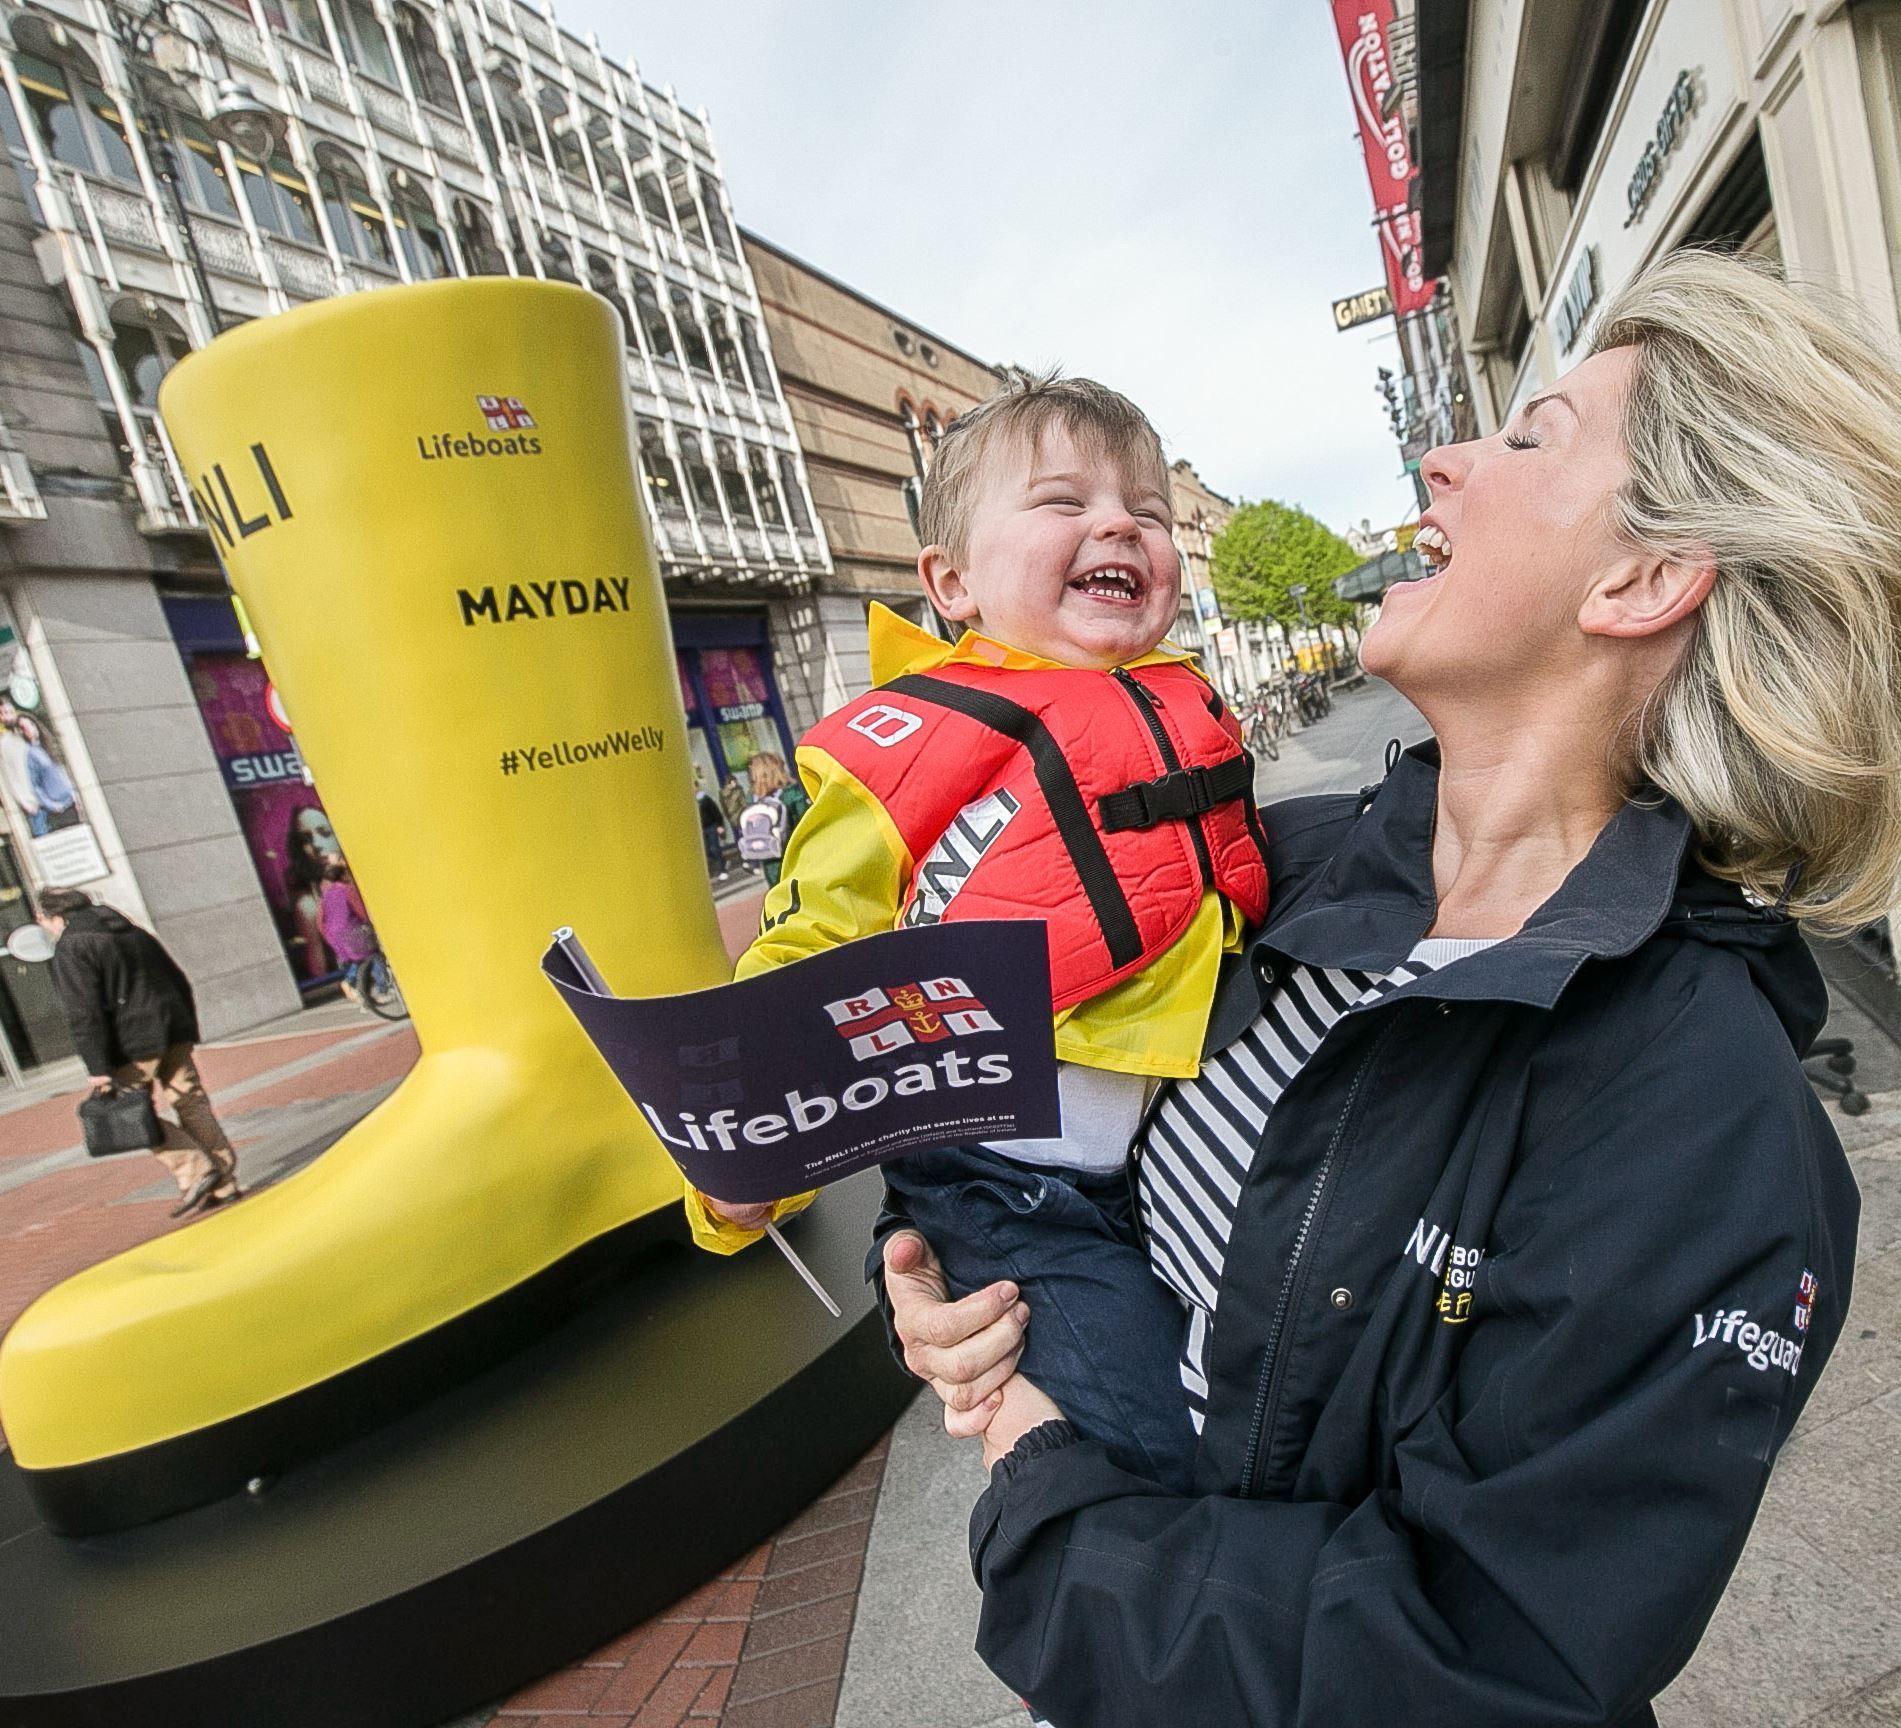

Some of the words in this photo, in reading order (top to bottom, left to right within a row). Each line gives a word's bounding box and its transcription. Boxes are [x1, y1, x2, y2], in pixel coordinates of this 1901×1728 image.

[417, 431, 542, 460] Lifeboats
[456, 577, 630, 627] MAYDAY
[500, 726, 664, 776] #YellowWelly
[641, 1050, 1013, 1152] Lifeboats
[804, 1160, 823, 1170] The
[825, 1148, 849, 1162] RNLI
[860, 1139, 876, 1149] the
[878, 1127, 911, 1142] charity
[912, 1123, 932, 1132] that
[933, 1120, 961, 1128] saves
